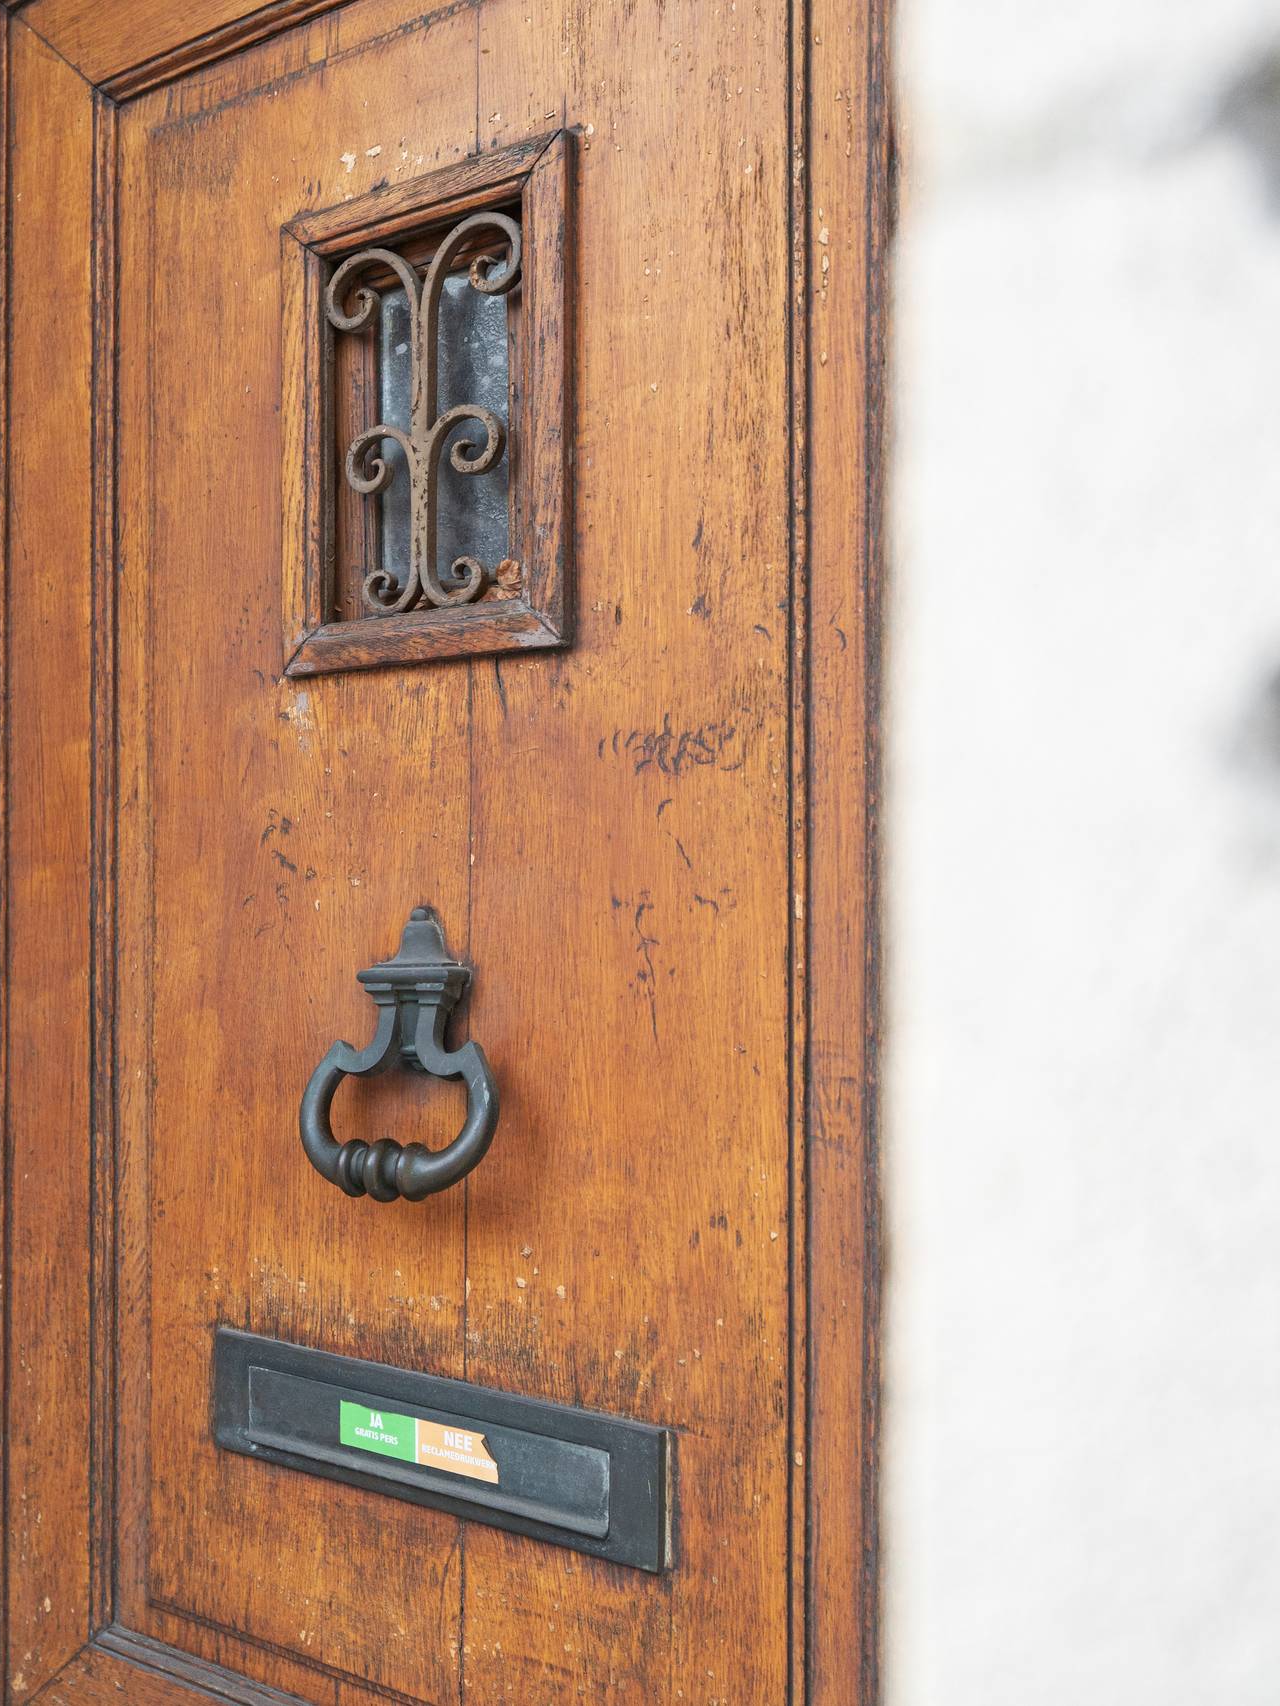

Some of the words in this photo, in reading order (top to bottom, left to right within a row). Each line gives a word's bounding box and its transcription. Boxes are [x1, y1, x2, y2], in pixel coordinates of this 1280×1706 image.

[370, 1412, 383, 1429] JA
[355, 1427, 378, 1440] GRATIS
[380, 1433, 398, 1445] PERS
[444, 1431, 472, 1451] NEE
